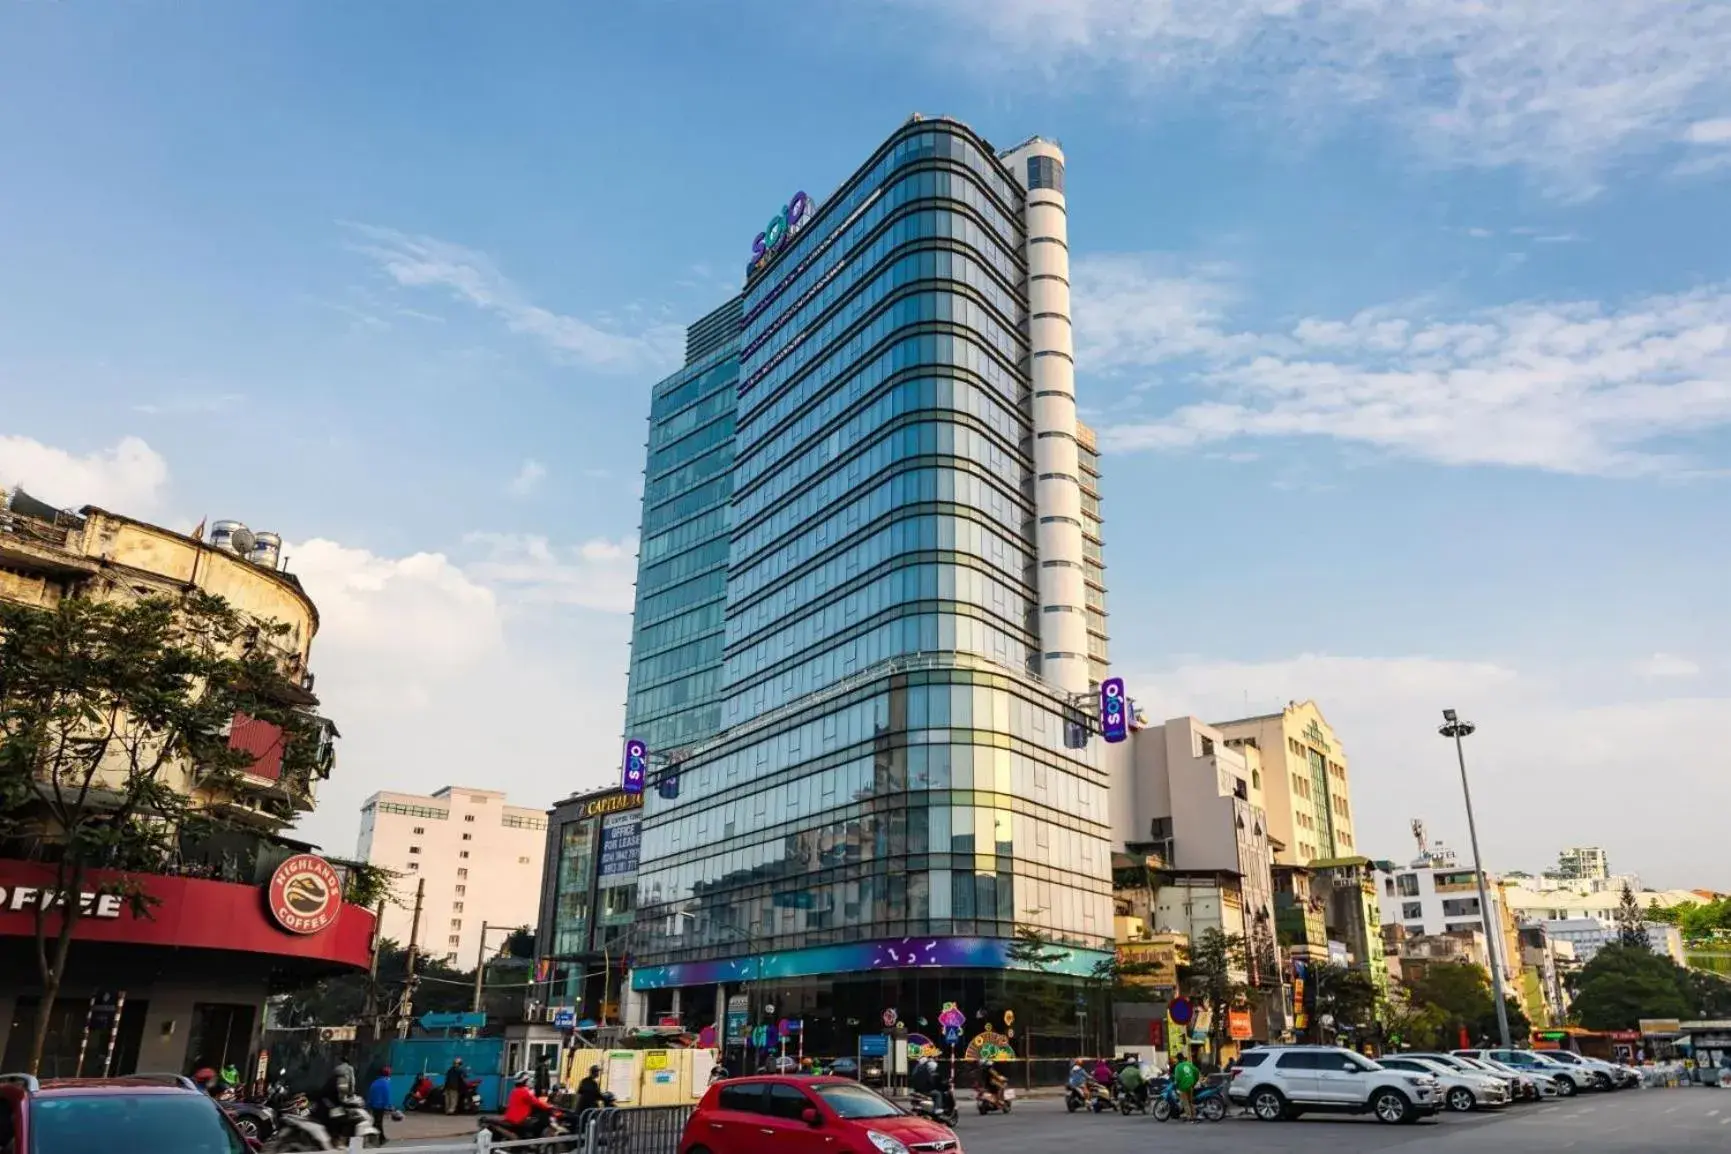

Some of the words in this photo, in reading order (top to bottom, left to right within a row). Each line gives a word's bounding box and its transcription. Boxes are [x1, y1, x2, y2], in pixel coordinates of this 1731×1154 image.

[1106, 684, 1124, 725] sojo
[628, 745, 645, 780] sojo
[588, 794, 629, 815] CAPITAL
[603, 839, 618, 851] FOR
[618, 835, 641, 849] LEASE
[611, 824, 635, 839] OFFICE
[276, 859, 339, 896] HIGHLANDS
[0, 886, 122, 918] FFEE
[278, 907, 328, 930] COFFEE
